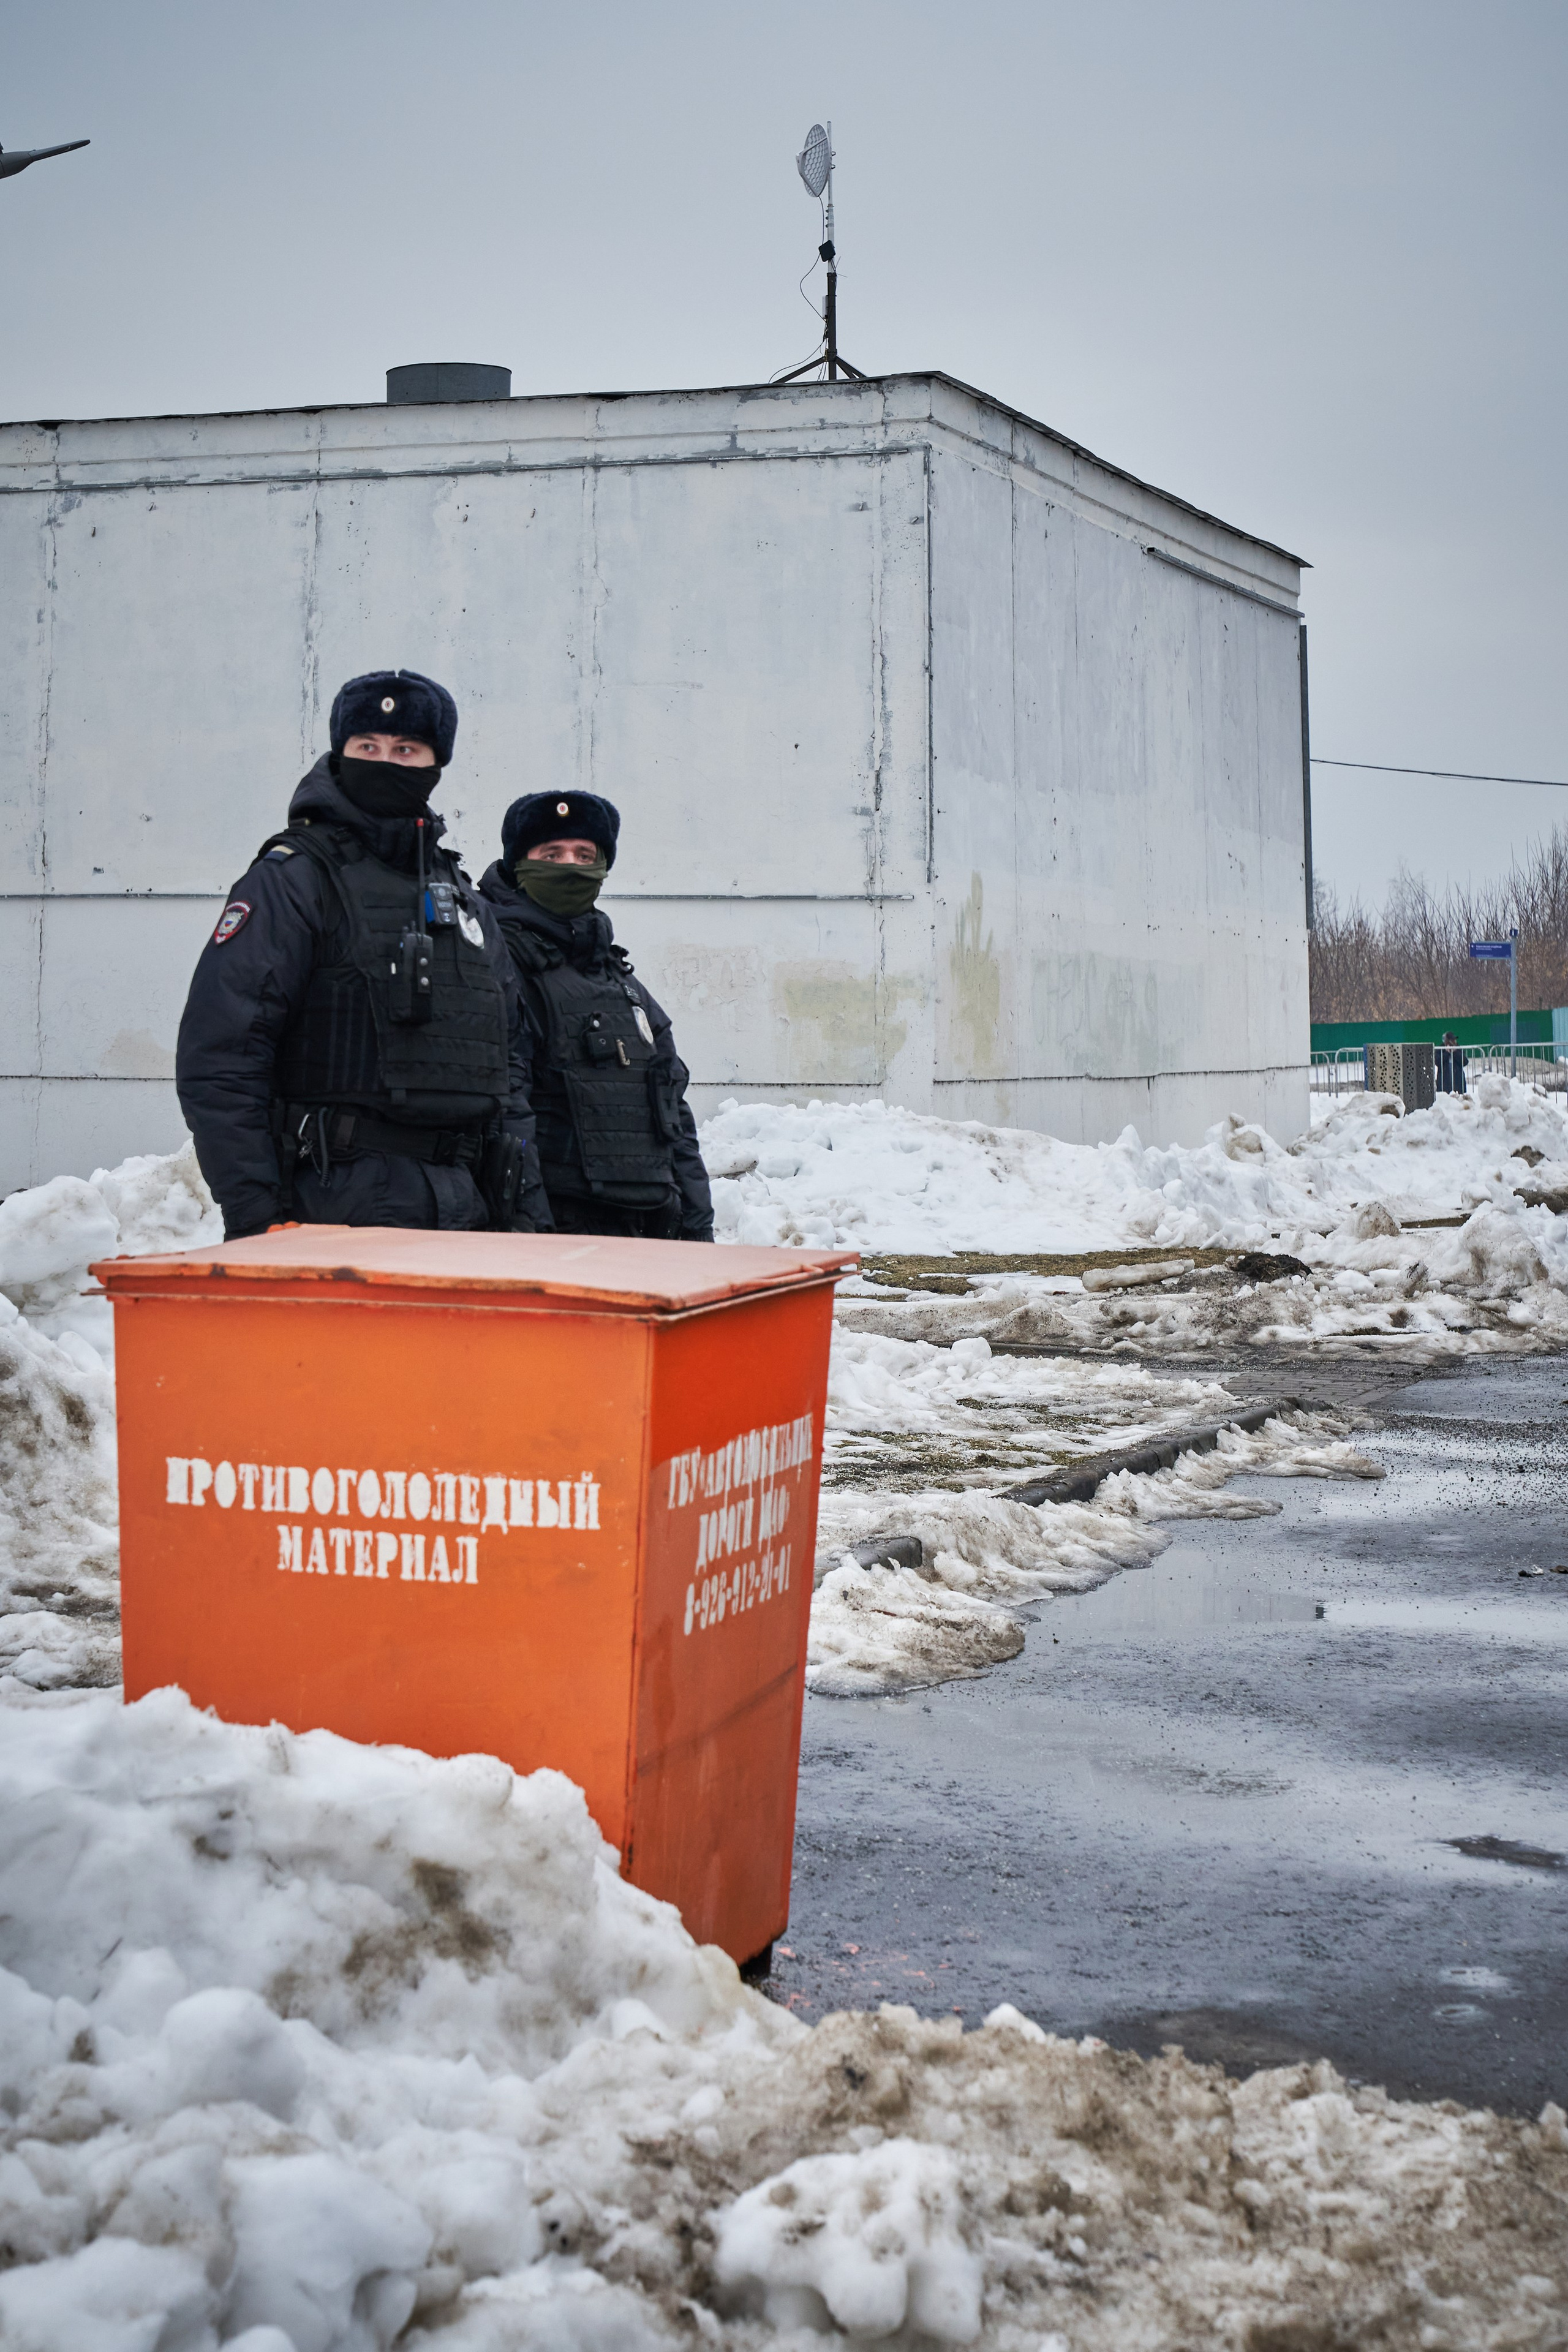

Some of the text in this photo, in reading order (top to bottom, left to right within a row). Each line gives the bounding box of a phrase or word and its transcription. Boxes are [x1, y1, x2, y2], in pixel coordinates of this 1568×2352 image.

[166, 1457, 600, 1534] ПРОТИВОГОЛОЛЕДНЫЙ
[277, 1525, 478, 1584] МАТЕРИАЛ
[695, 1497, 754, 1575] ДОРОГИ
